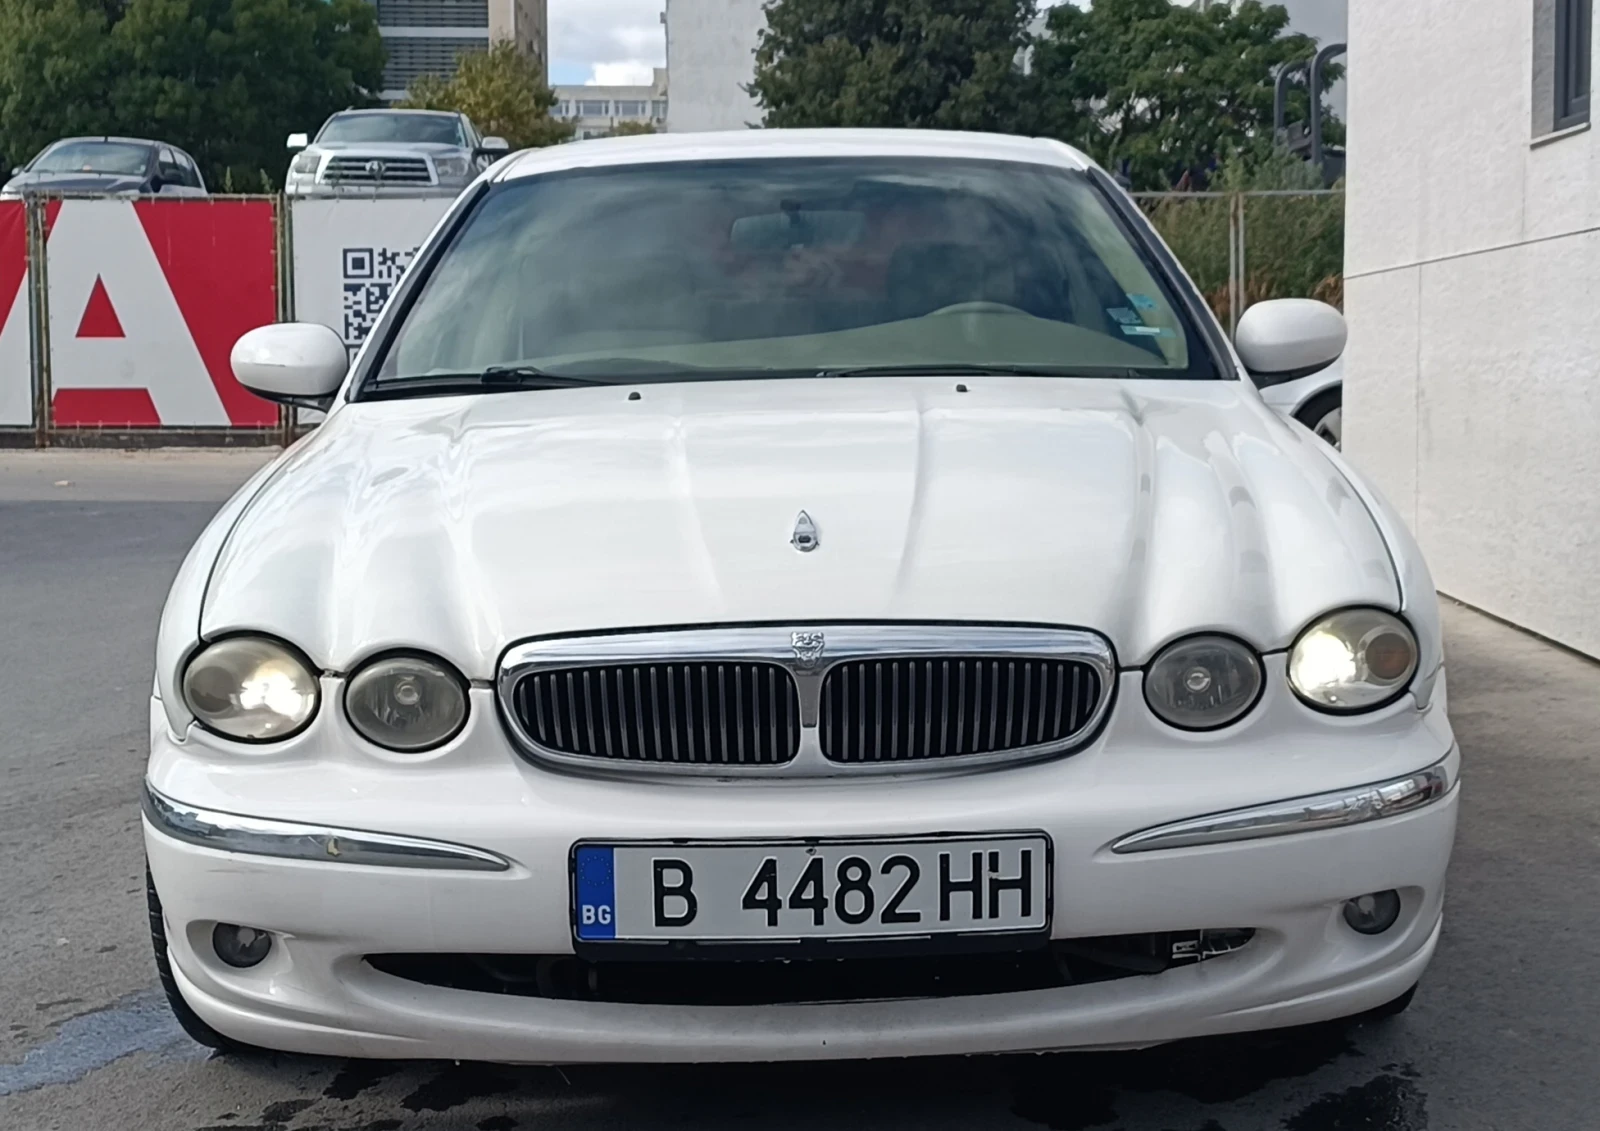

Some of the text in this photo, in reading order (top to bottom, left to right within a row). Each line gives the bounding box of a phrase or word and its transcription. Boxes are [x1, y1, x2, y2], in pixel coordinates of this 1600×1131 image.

[0, 199, 232, 425] A
[582, 904, 611, 925] BG
[653, 849, 1032, 927] B 4482 HH
